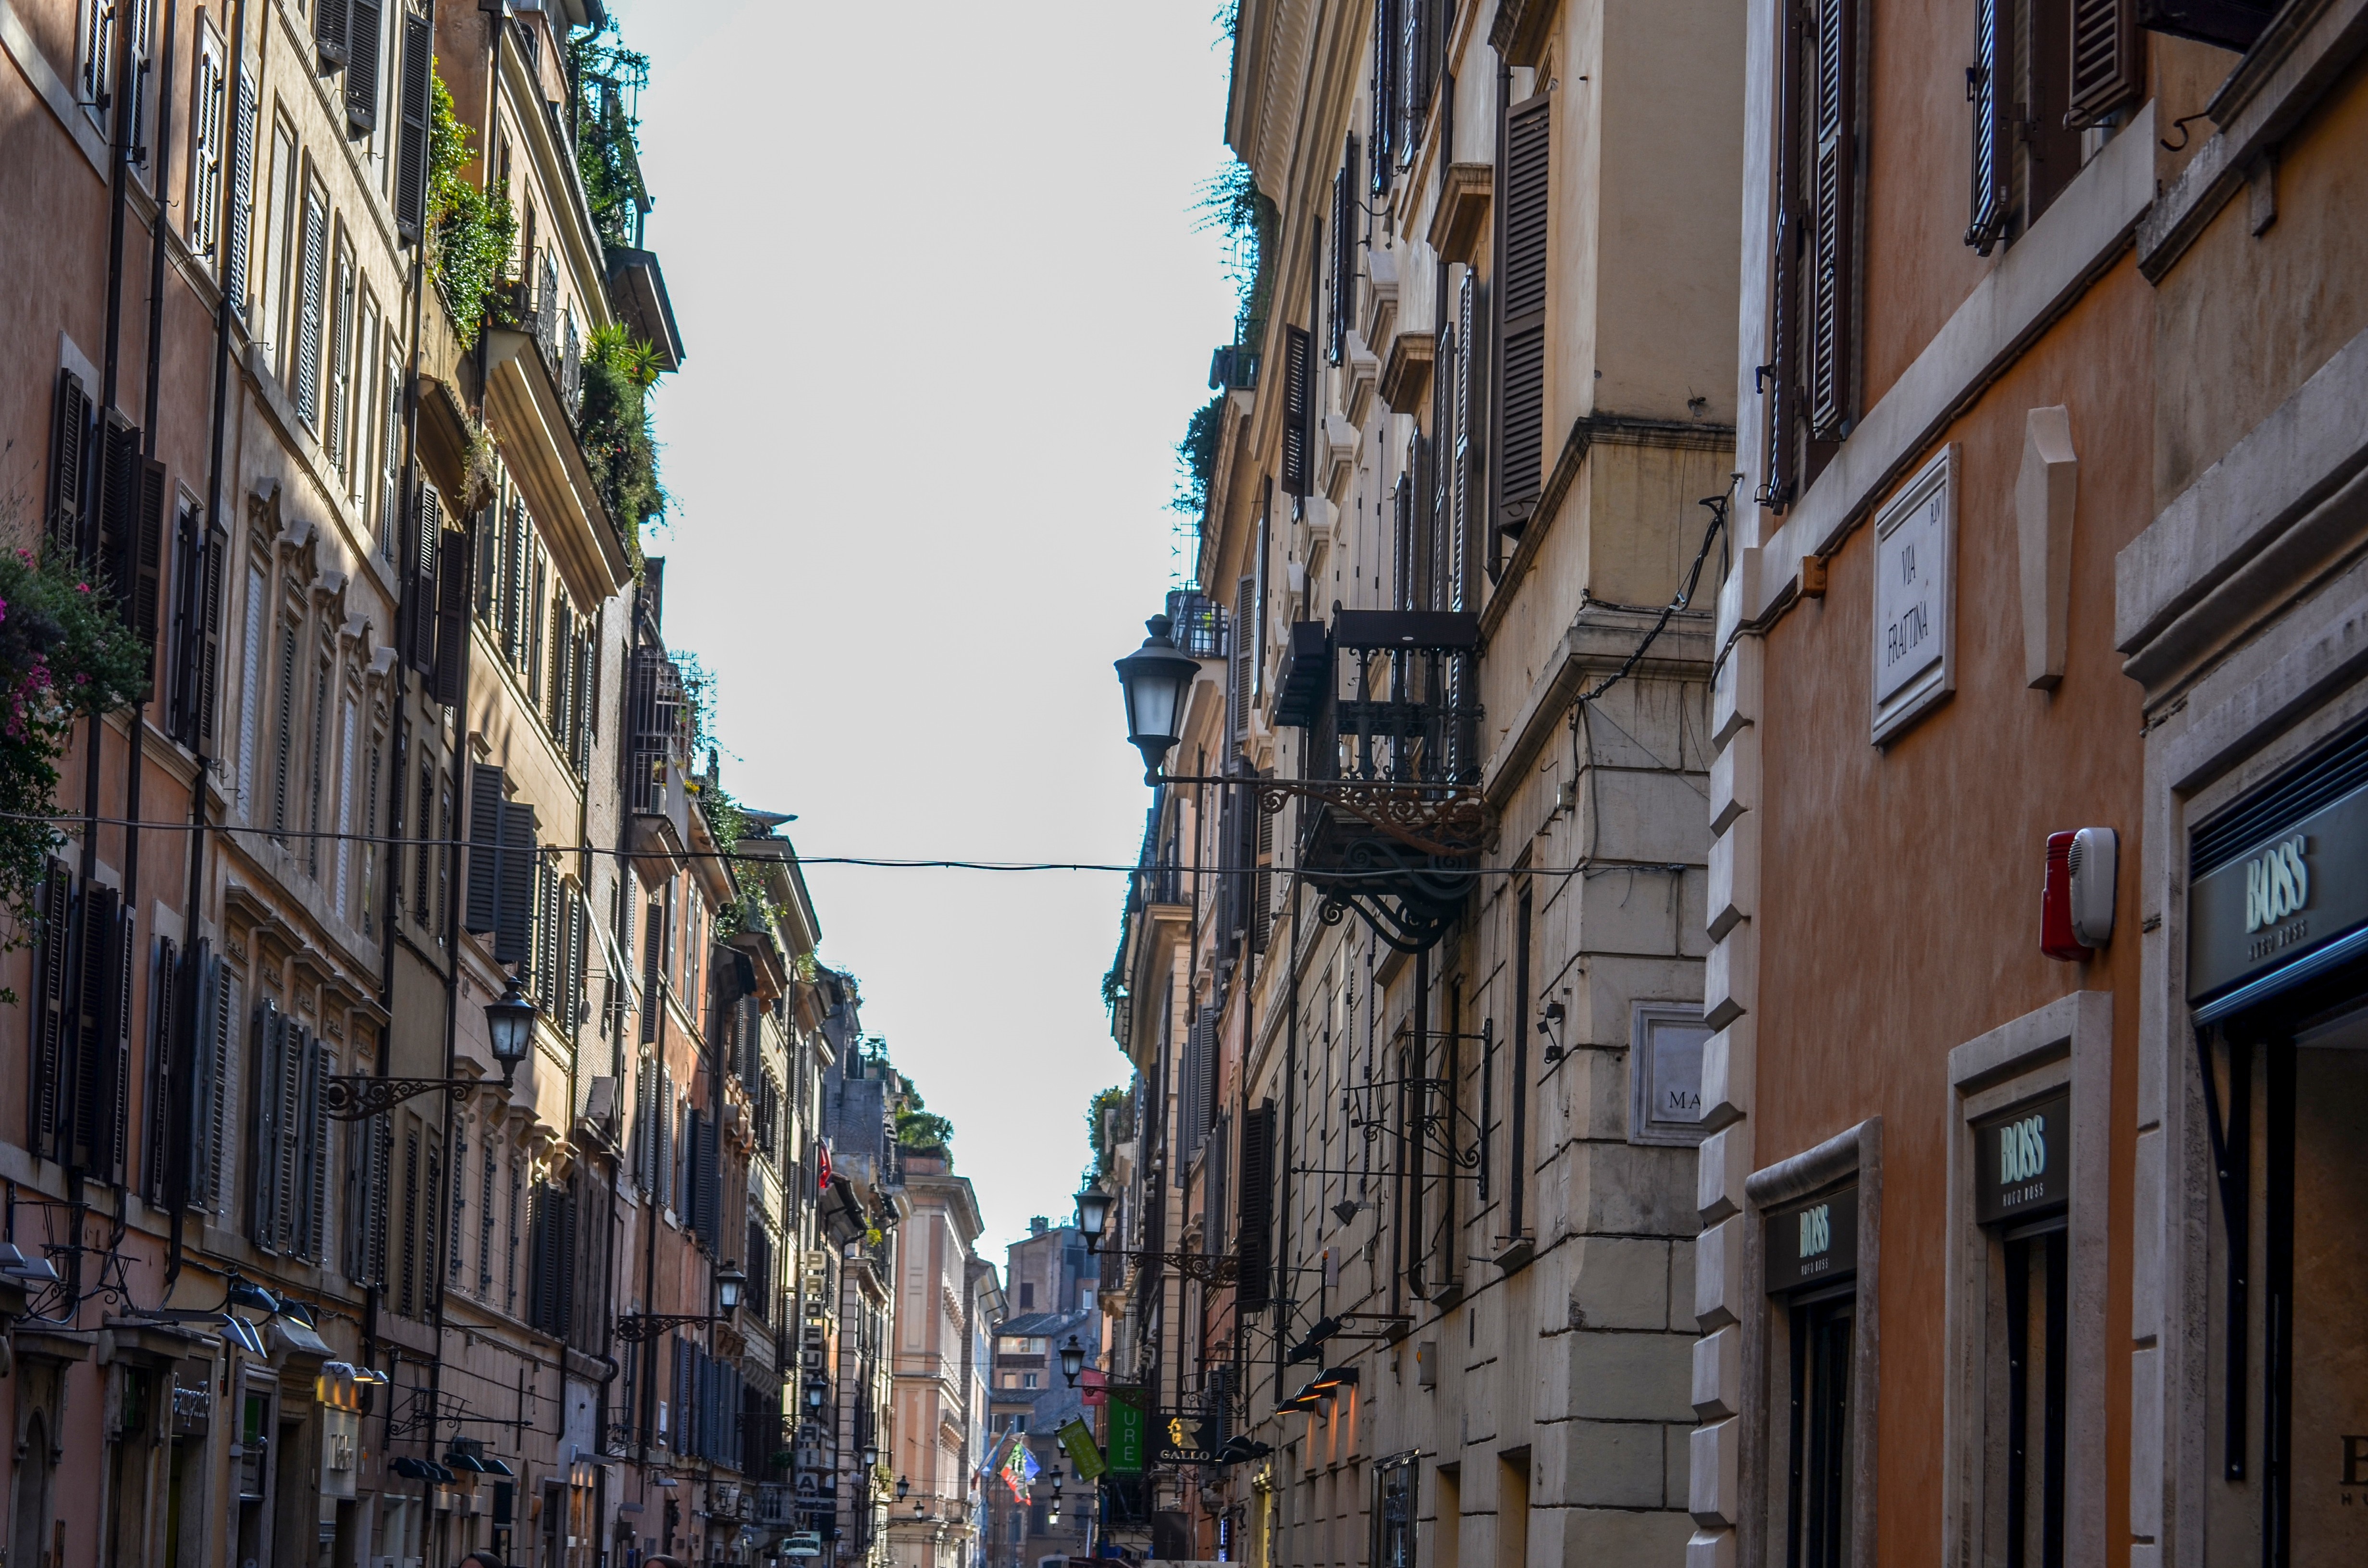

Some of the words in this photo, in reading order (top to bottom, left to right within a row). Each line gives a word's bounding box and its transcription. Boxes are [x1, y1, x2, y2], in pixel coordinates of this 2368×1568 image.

[1901, 543, 1916, 586] VIA
[1887, 600, 1928, 667] FRATTINA
[2245, 834, 2308, 934] BOSS
[2248, 935, 2274, 962] HUGO
[2278, 919, 2307, 947] BOSS
[2000, 1115, 2047, 1185] BOSS
[2003, 1189, 2021, 1207] HUGO
[2024, 1182, 2044, 1201] BOSS
[1800, 1204, 1829, 1259] BOSS
[1801, 1262, 1813, 1276] HUGO
[1815, 1257, 1828, 1272] BOSS
[1065, 1426, 1084, 1439] PURE
[1160, 1449, 1210, 1460] GALLO
